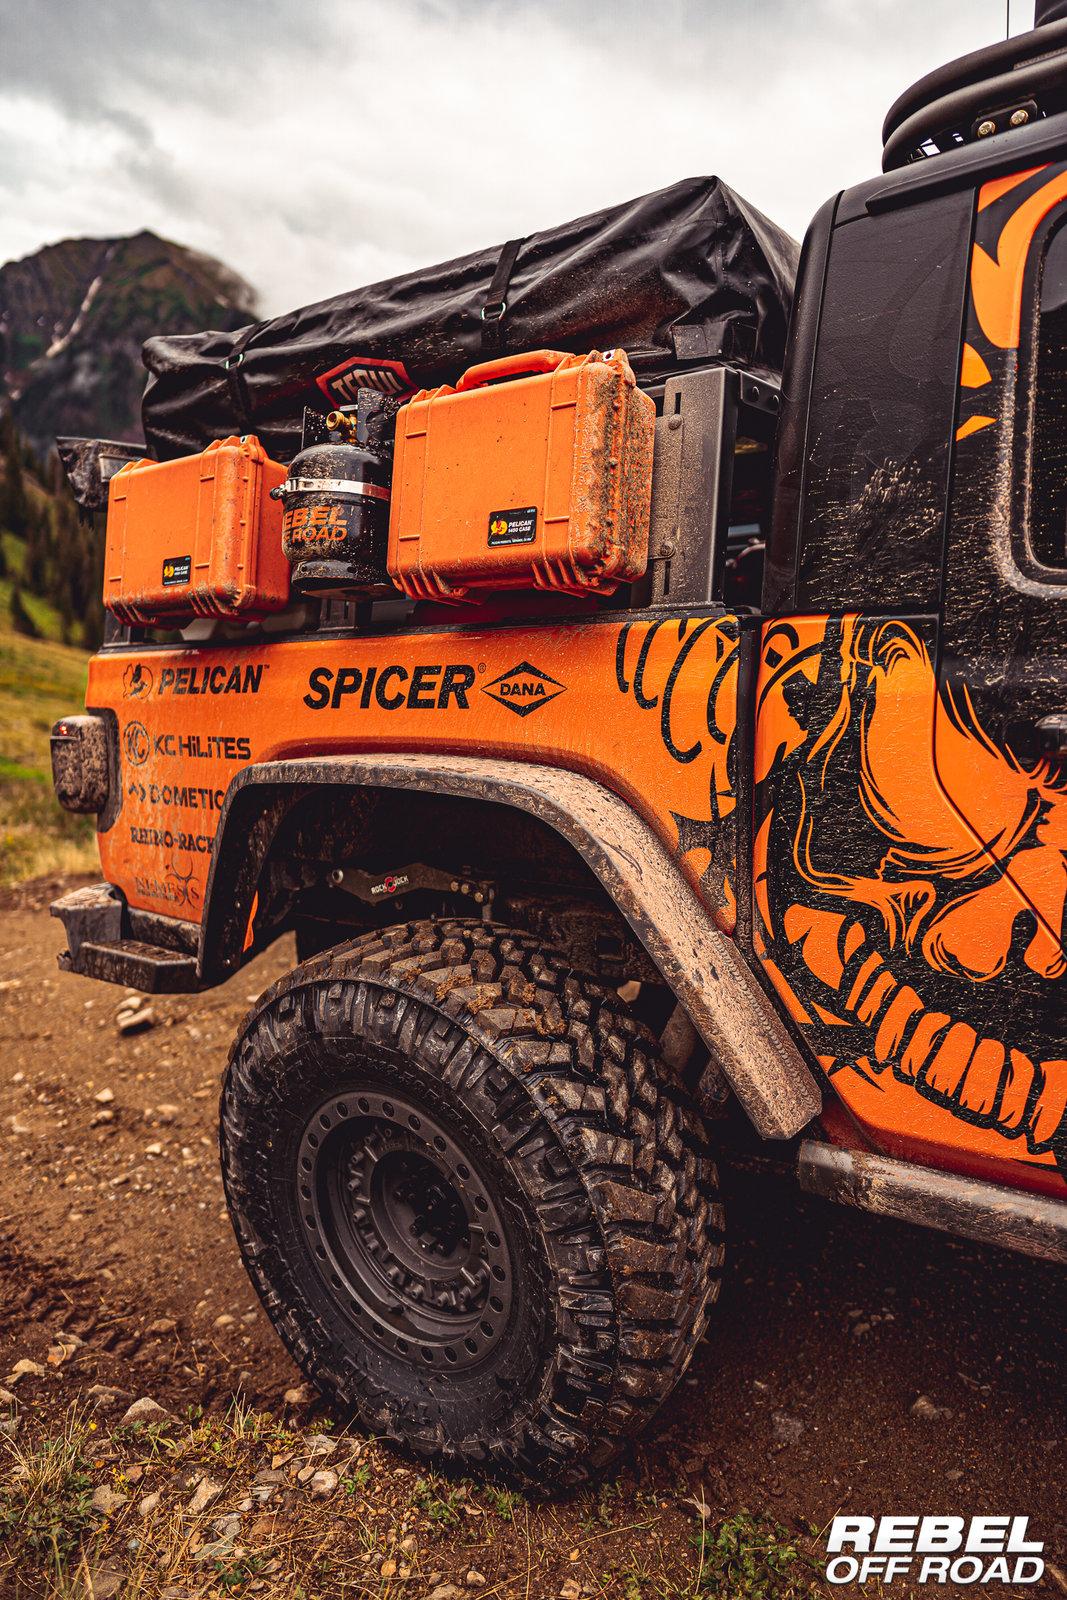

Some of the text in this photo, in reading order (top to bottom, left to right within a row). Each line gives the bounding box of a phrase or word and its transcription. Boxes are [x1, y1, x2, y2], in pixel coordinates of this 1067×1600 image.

[285, 506, 348, 528] EBEL
[508, 520, 533, 528] PELICAN
[158, 664, 263, 695] PELICAN
[303, 665, 476, 710] SPICER
[500, 683, 546, 696] DANA
[154, 734, 176, 756] KC
[149, 784, 225, 811] DOMETIC
